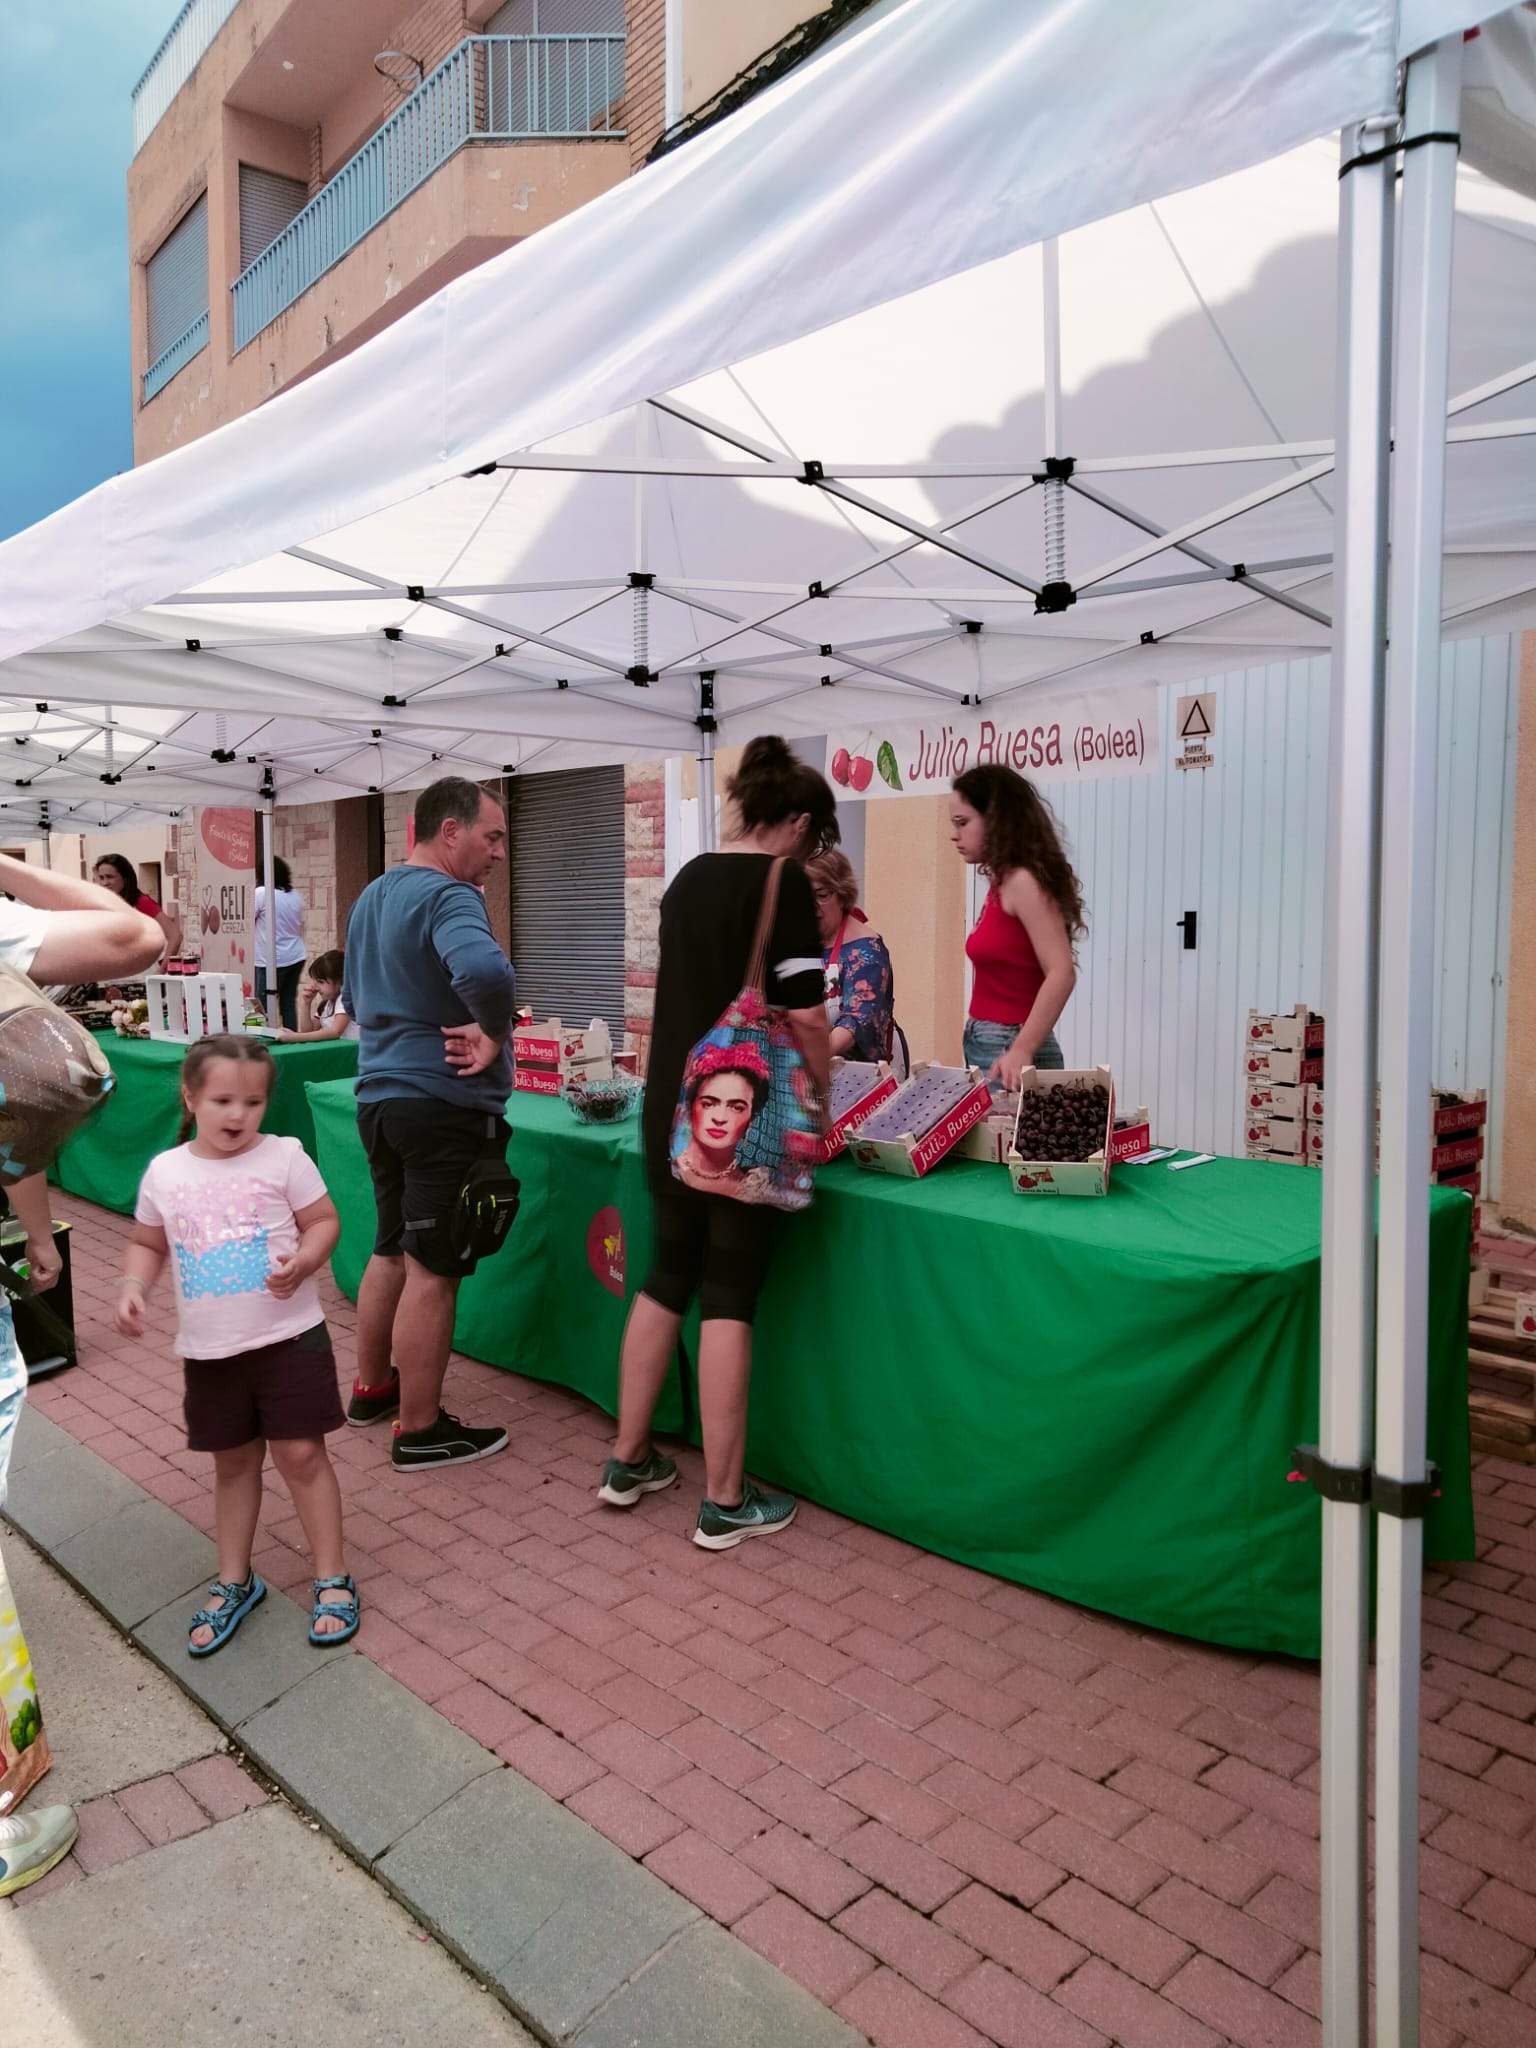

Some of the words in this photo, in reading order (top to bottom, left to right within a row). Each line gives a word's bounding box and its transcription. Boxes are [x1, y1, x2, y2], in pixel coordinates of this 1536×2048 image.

[909, 726, 968, 781] Julio
[977, 721, 1063, 770] Buesa
[1074, 718, 1145, 771] (Bolea)
[530, 1043, 553, 1058] Buesa
[533, 1076, 557, 1091] Buesa
[917, 1136, 947, 1170] Julio
[946, 1100, 982, 1138] Buesa
